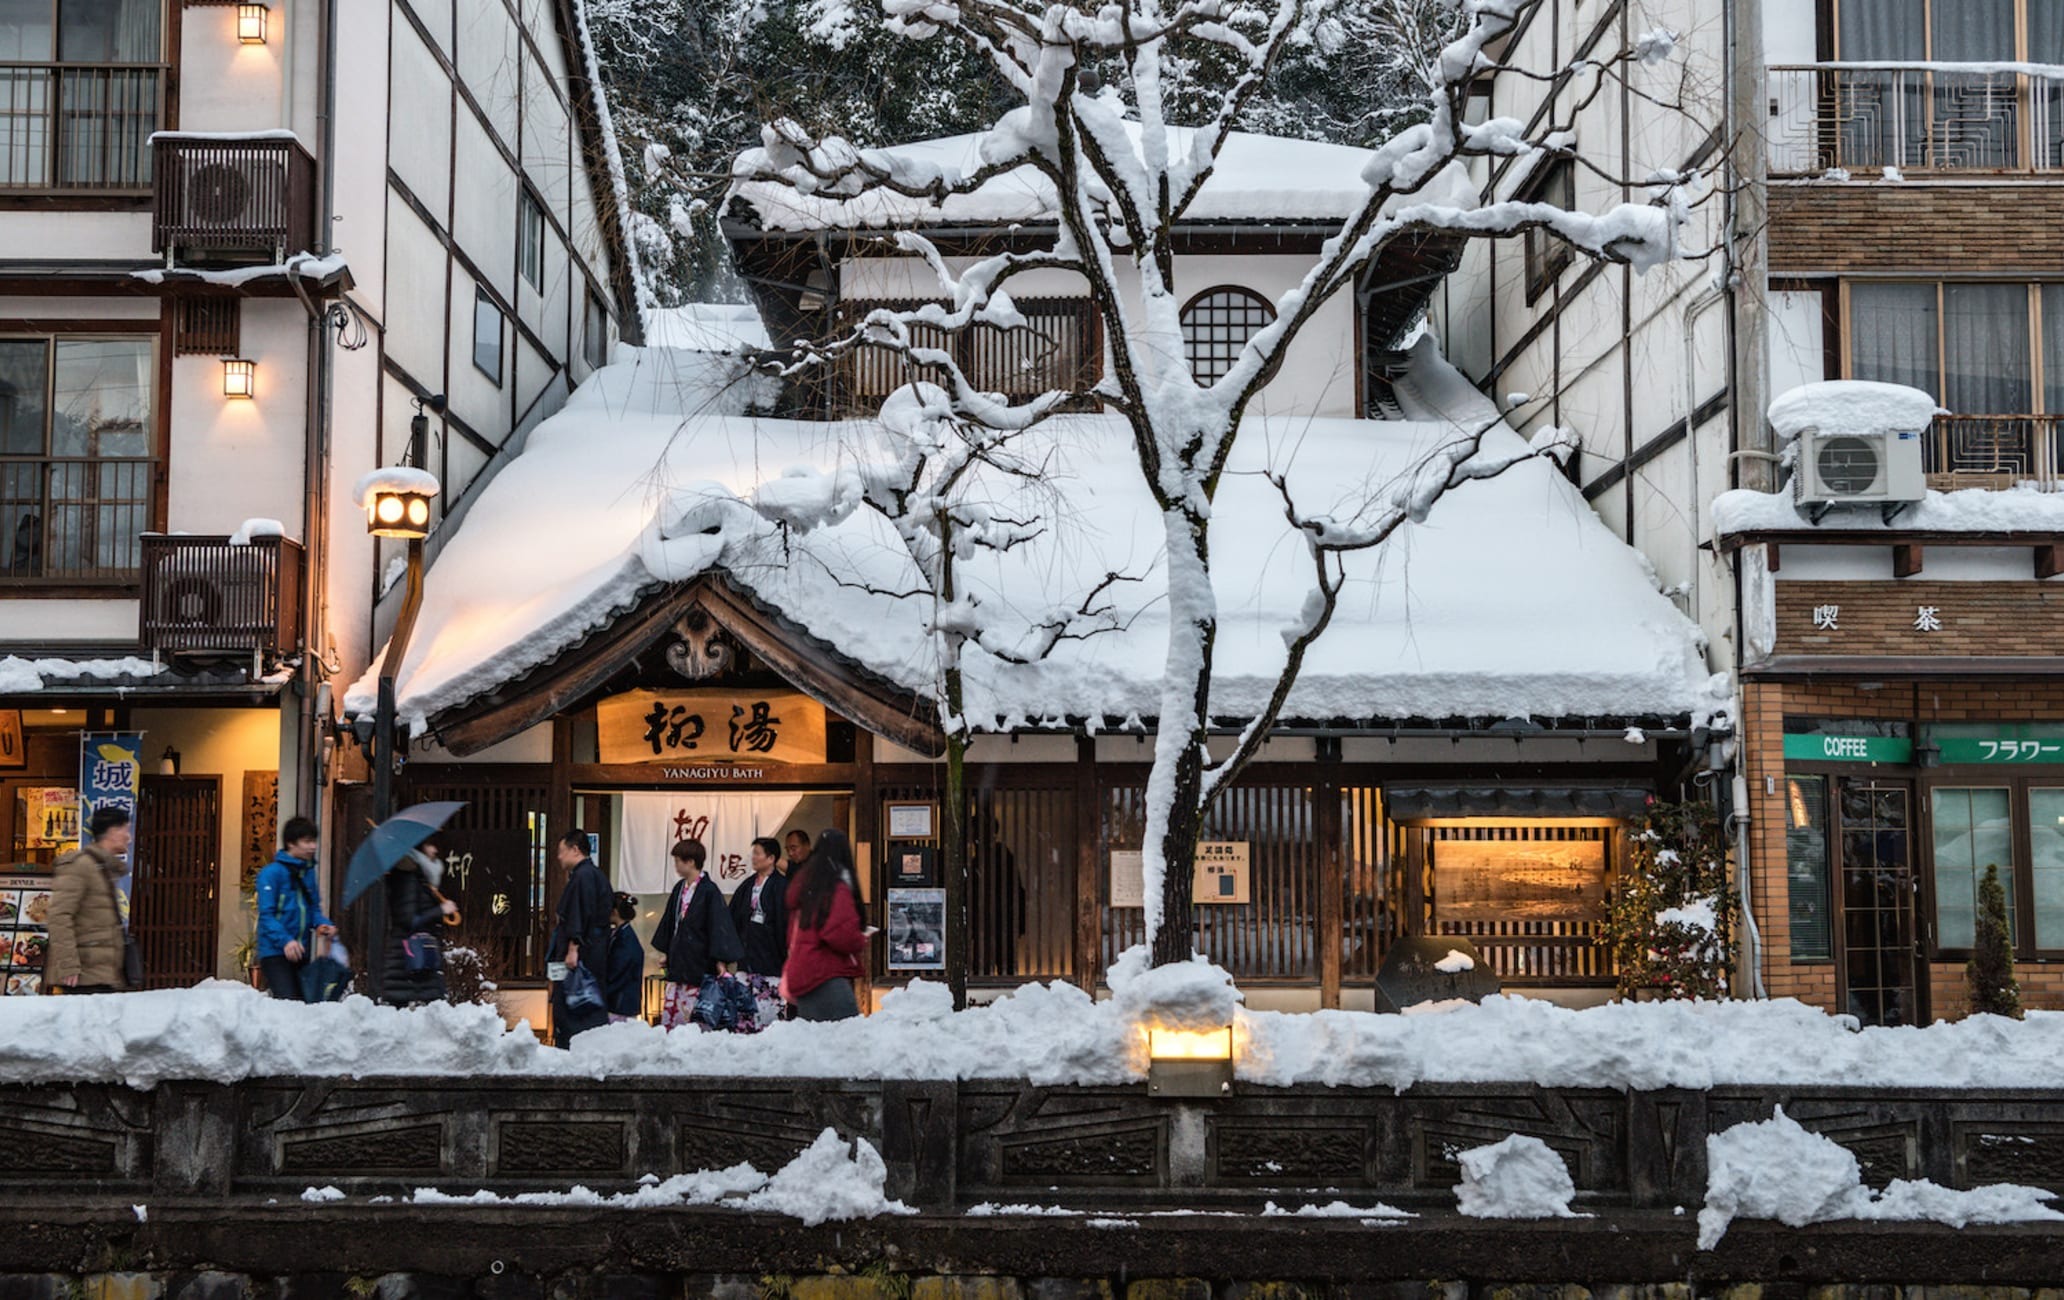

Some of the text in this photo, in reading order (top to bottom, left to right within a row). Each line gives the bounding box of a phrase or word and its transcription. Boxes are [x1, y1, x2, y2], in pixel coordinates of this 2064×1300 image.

[1813, 604, 1943, 632] 喫茶
[643, 701, 782, 755] 柳湯
[1823, 737, 1868, 757] COFFEE
[1978, 740, 2061, 761] フラワー
[663, 767, 730, 779] YANAGIYU
